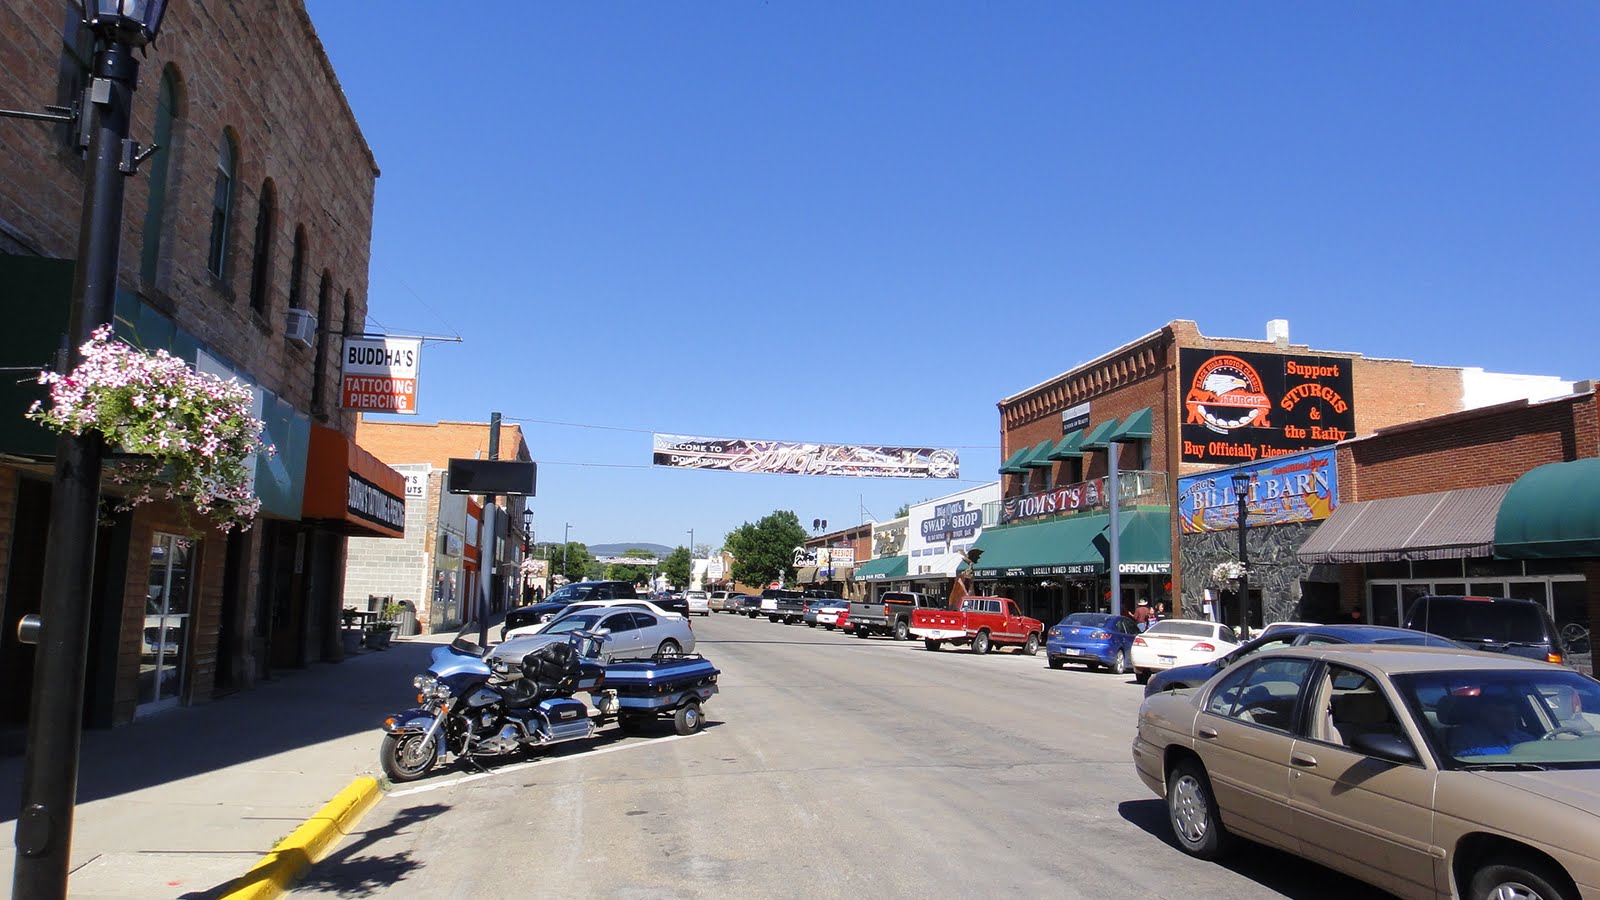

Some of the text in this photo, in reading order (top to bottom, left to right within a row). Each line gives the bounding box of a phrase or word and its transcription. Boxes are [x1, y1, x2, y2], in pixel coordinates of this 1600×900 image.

[348, 346, 414, 367] BUDDHA'S
[1223, 359, 1244, 370] MOTOR
[1286, 360, 1340, 379] Support
[346, 377, 414, 394] TATTOOING
[350, 393, 407, 409] PIERCING
[1220, 394, 1260, 405] STURGIS
[1280, 382, 1349, 414] STURGIS
[1309, 406, 1321, 420] &
[1284, 424, 1347, 441] the Rally
[656, 440, 707, 453] WELCOME
[1183, 440, 1206, 459] Buy
[1208, 441, 1258, 461] Officially
[670, 454, 731, 467] DOWNTOWN
[1179, 477, 1217, 504] STURGIS
[1192, 469, 1330, 511] BILLT BARN
[1018, 487, 1080, 518] TOM'S T'S
[923, 518, 946, 534] SWAP
[951, 511, 978, 529] SHOP
[831, 549, 853, 557] IRESIDE
[1052, 566, 1067, 574] OWNED
[1068, 565, 1081, 574] SINCE
[1118, 563, 1160, 573] OFFICIAL
